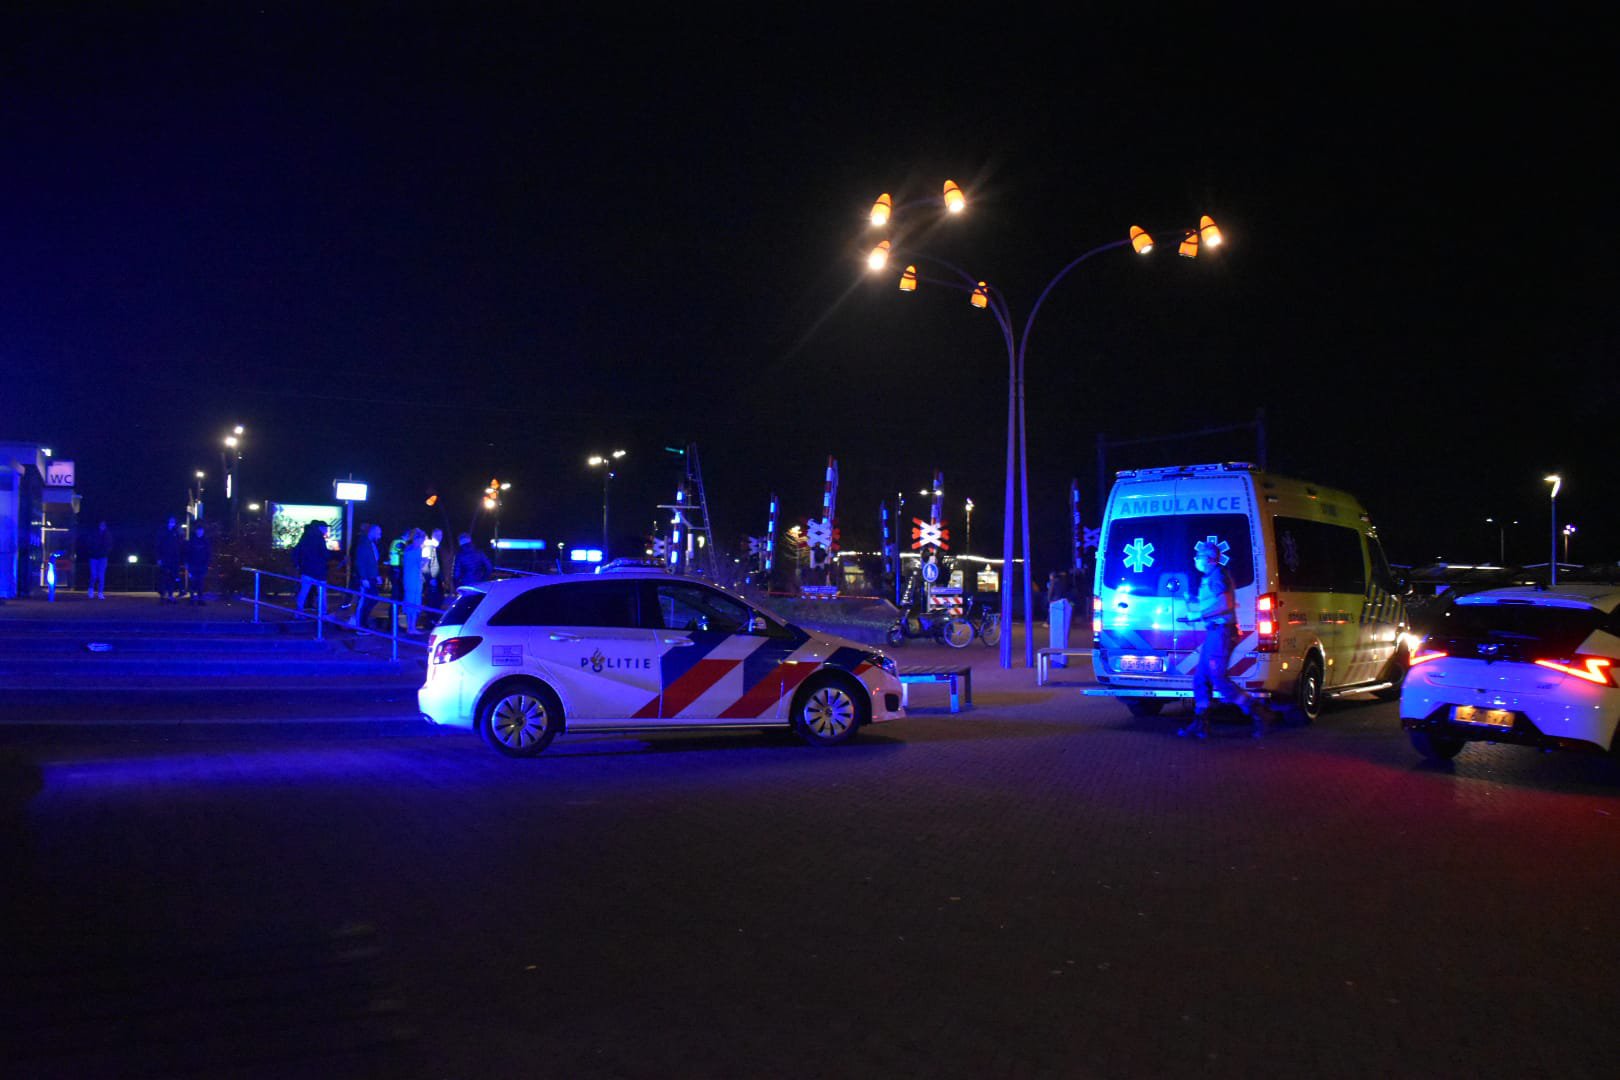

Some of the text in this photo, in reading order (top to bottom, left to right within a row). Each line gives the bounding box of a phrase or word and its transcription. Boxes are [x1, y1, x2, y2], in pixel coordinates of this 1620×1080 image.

[50, 474, 72, 484] WC
[1120, 497, 1240, 516] AMBULANCE
[581, 657, 651, 672] POLITIE
